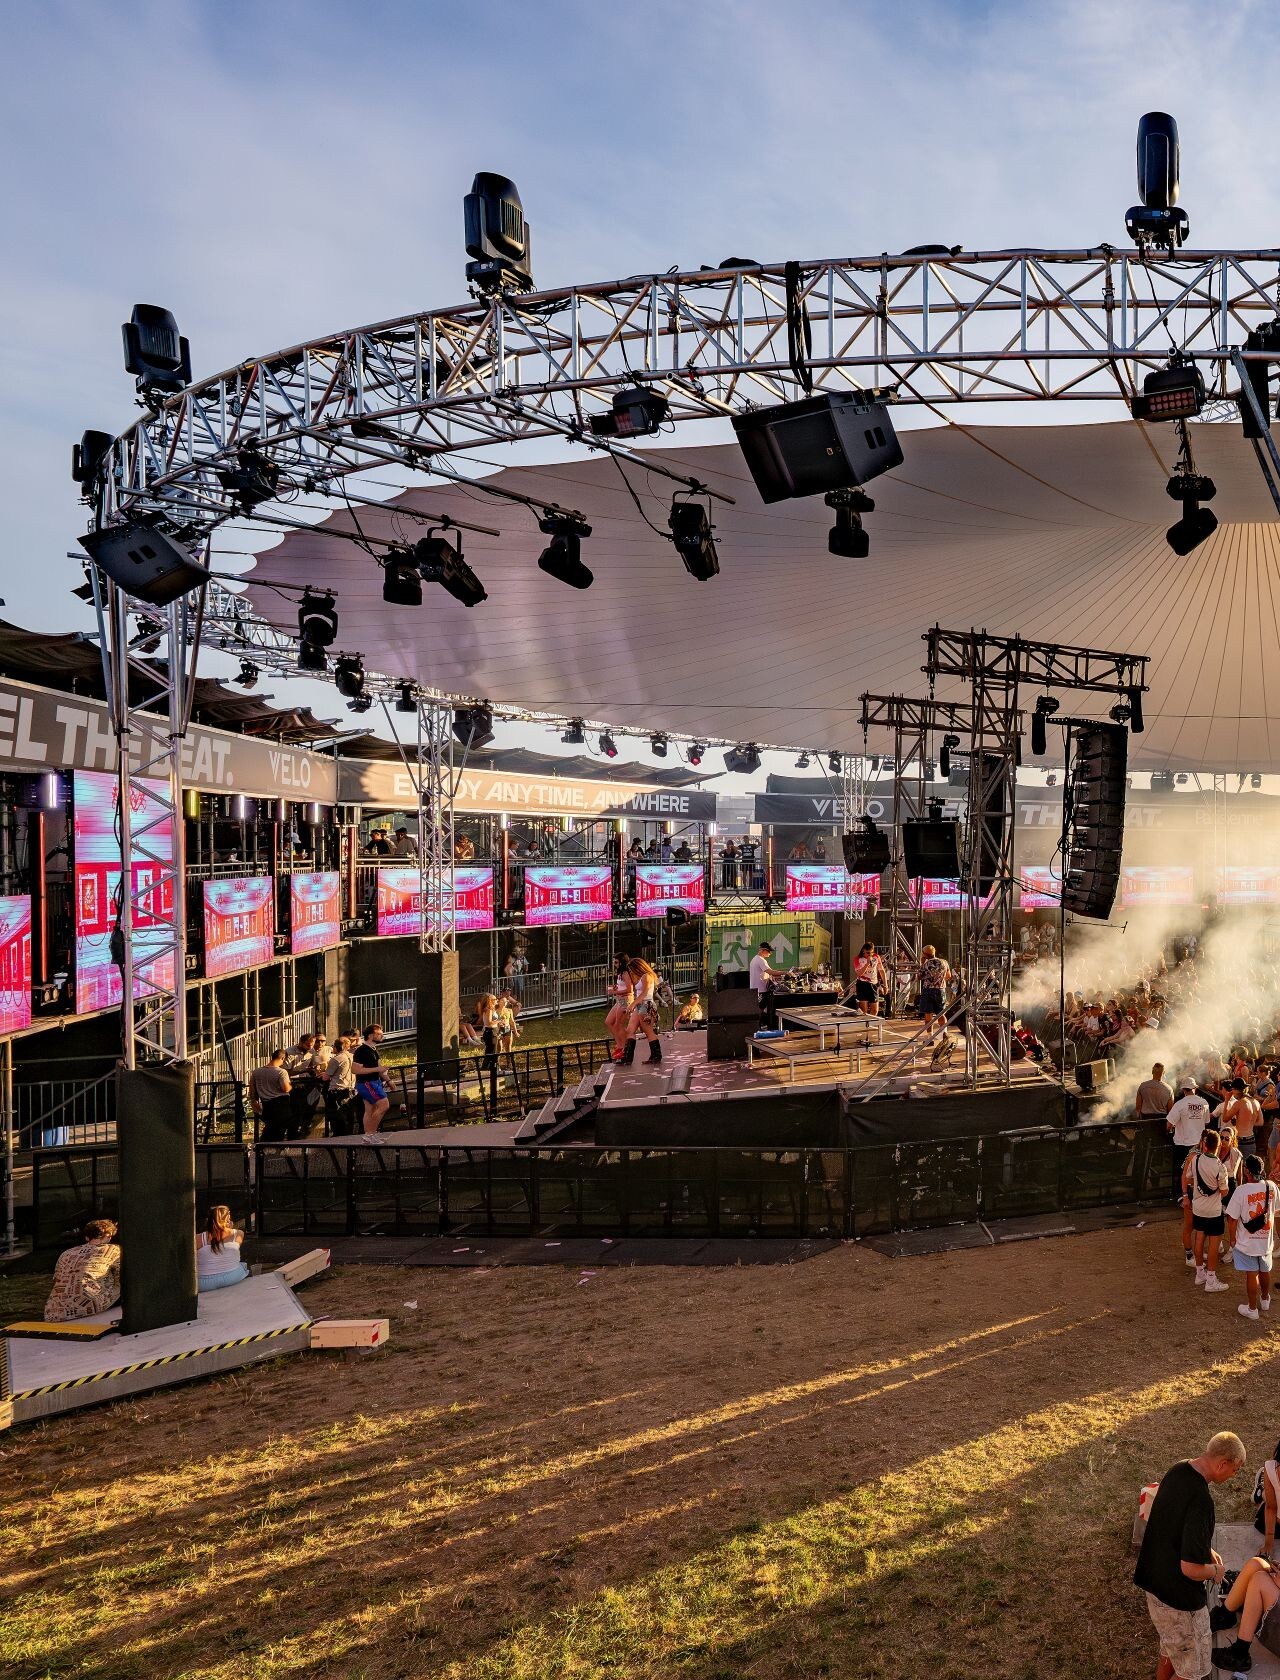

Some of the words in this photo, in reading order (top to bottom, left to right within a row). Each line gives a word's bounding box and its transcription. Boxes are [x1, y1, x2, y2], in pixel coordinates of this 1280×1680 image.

[56, 705, 143, 772] THE
[268, 751, 311, 788] VELO
[484, 781, 588, 810] ANYTIME,
[590, 790, 689, 813] ANYWHERE
[811, 799, 884, 818] VEO
